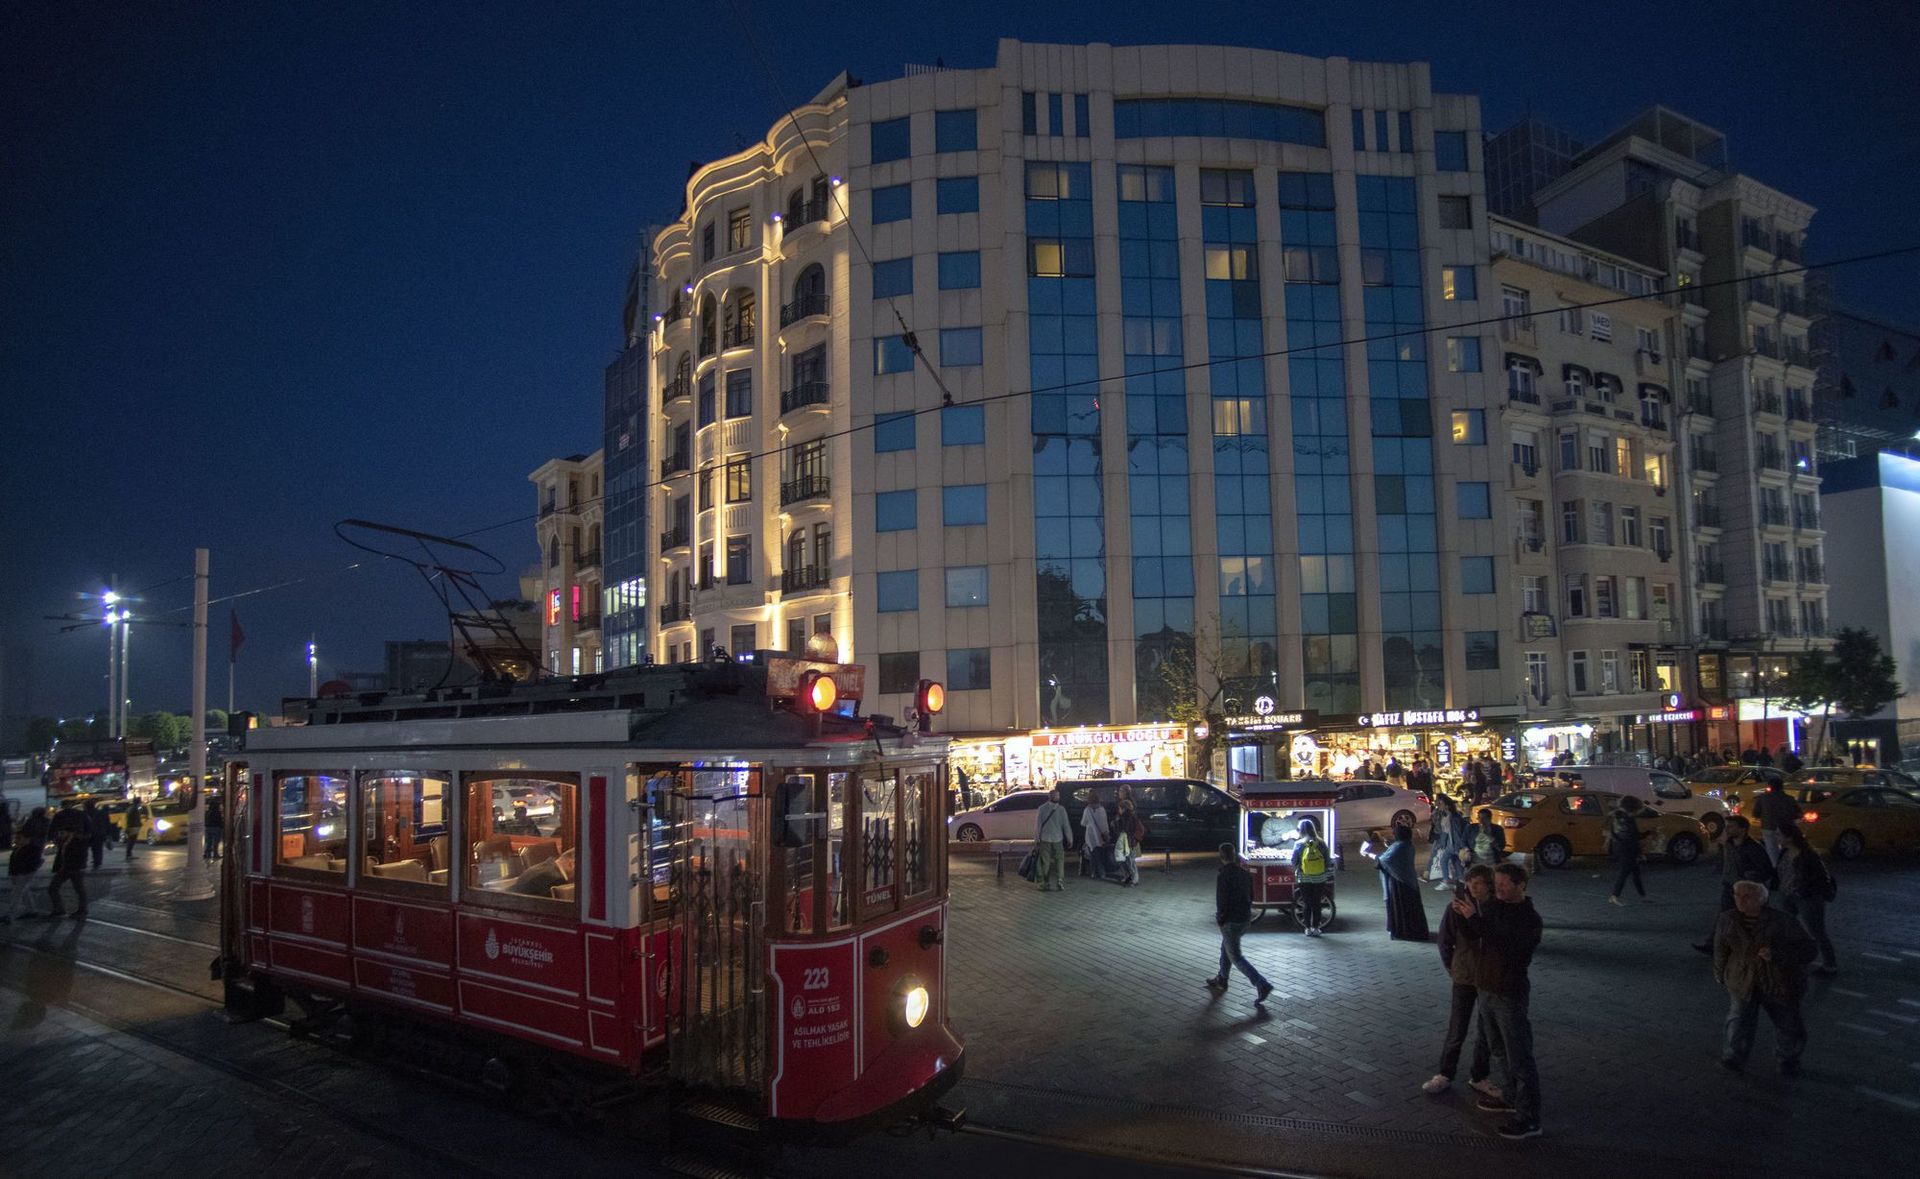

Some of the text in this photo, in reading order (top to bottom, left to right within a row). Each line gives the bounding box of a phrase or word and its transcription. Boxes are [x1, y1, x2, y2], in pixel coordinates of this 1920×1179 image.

[1264, 714, 1302, 724] SQUARE
[865, 890, 892, 905] TÜNEL
[502, 943, 554, 963] BÜYÜKŞEHİR
[804, 967, 829, 990] 223
[794, 1019, 849, 1036] ASILMAK YASAK
[792, 1039, 802, 1049] VE
